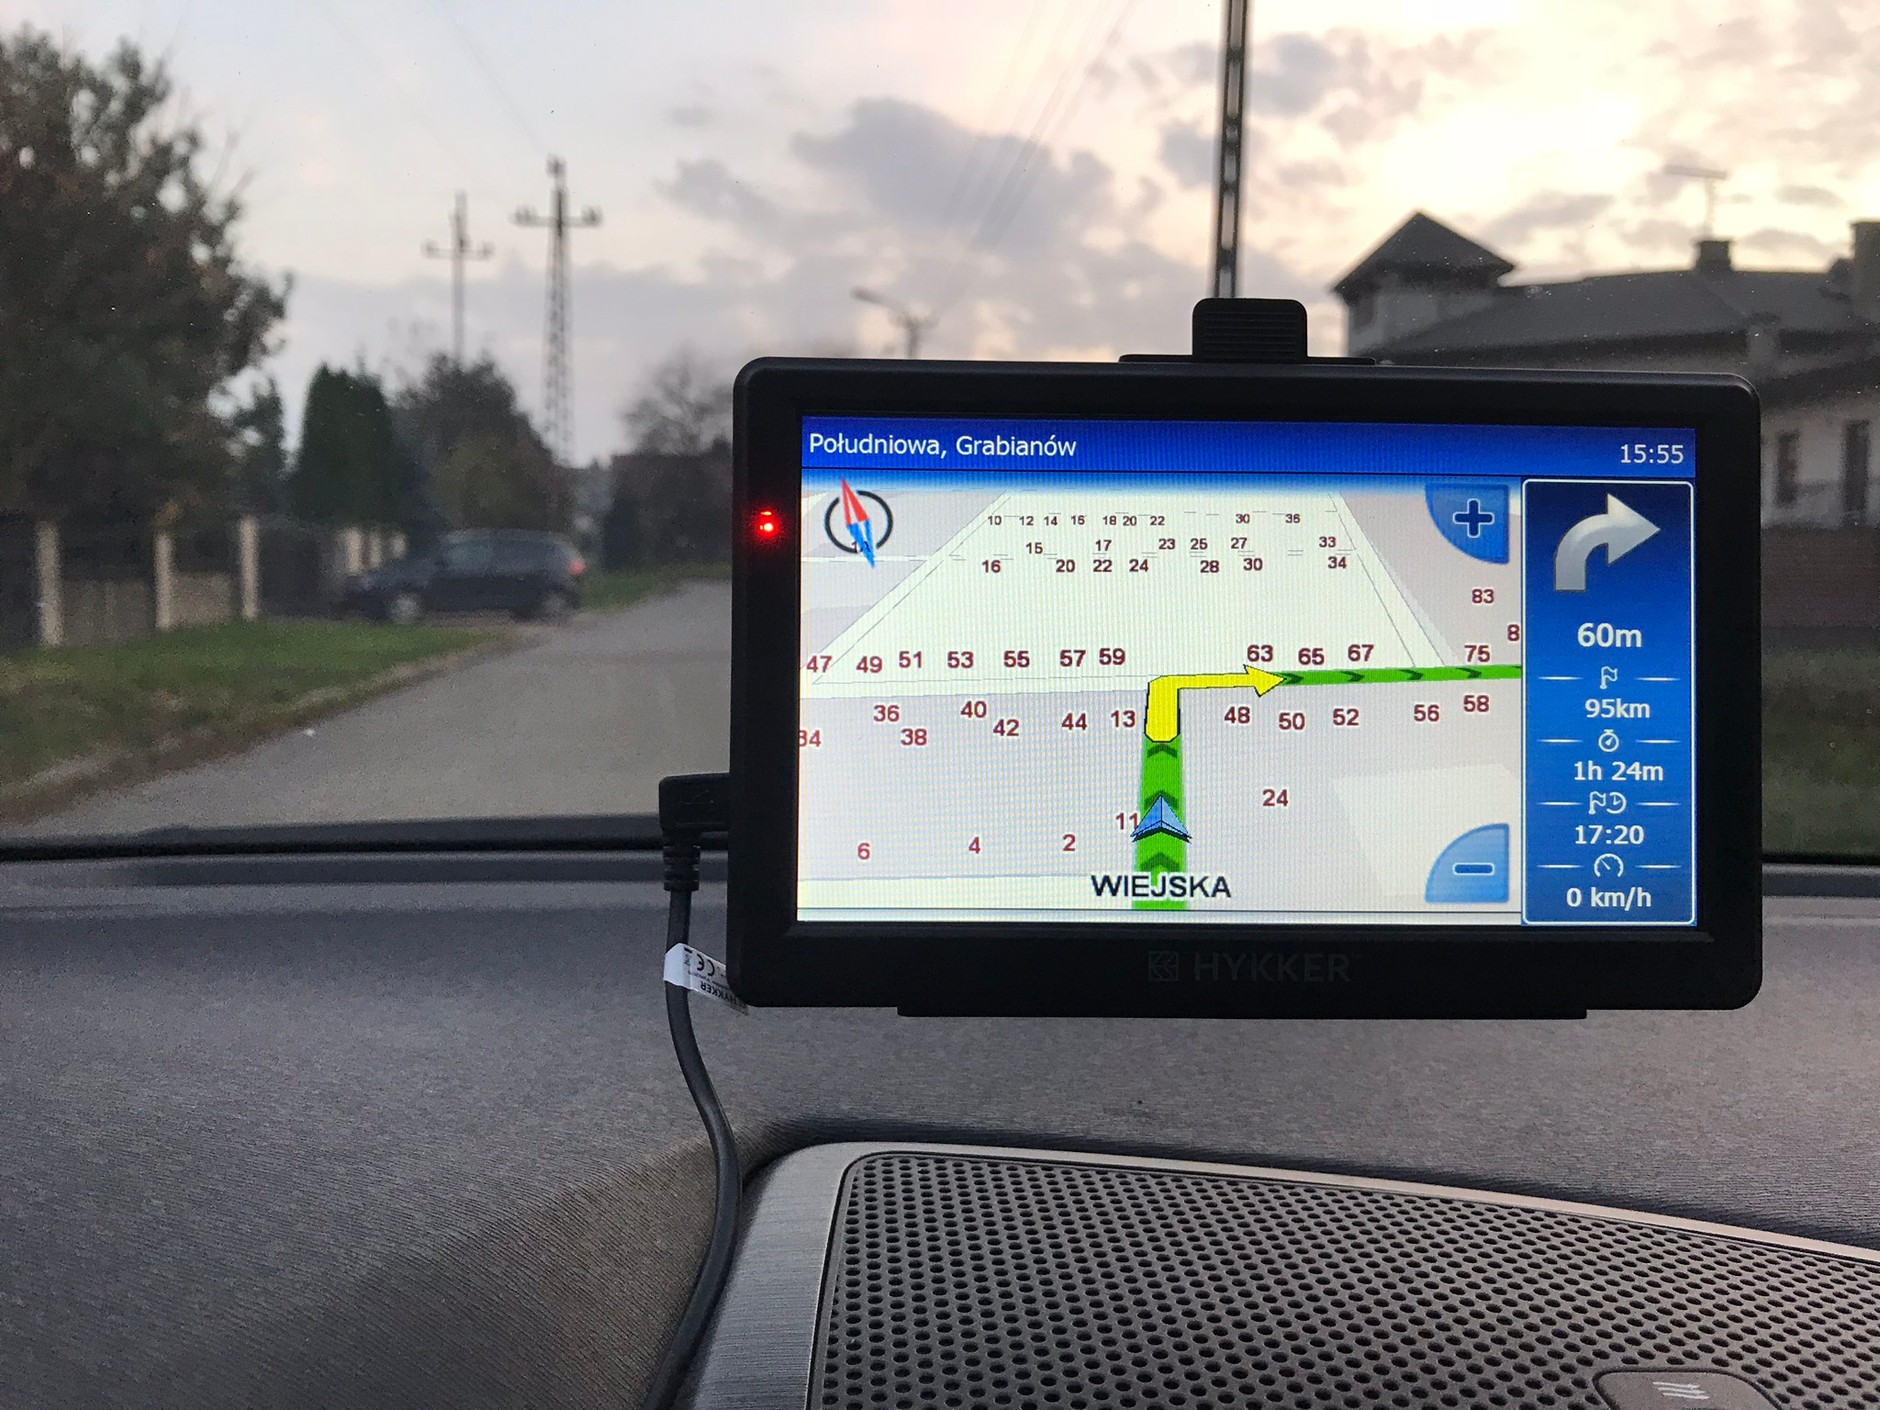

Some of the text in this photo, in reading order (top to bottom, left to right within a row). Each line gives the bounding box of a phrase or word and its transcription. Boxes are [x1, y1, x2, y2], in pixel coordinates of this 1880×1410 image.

[809, 433, 1077, 459] Południowa, Grabianów
[1620, 444, 1685, 464] 15:55
[988, 516, 1002, 526] 10
[1019, 516, 1034, 526] 12
[1044, 516, 1058, 526] 14
[1102, 516, 1117, 525] 18
[1122, 516, 1137, 526] 20
[1150, 516, 1165, 526] 22
[1236, 514, 1250, 524] 30
[1096, 539, 1111, 551] 17
[1158, 538, 1176, 550] 23
[1230, 537, 1248, 549] 27
[1319, 536, 1337, 548] 33
[982, 560, 1001, 573] 16
[1056, 560, 1075, 572] 20
[1093, 560, 1112, 572] 22
[1129, 559, 1149, 572] 24
[1200, 560, 1219, 573] 28
[1243, 558, 1263, 571] 30
[1327, 556, 1347, 569] 34
[1471, 588, 1495, 604] 83
[1577, 622, 1643, 648] 60m
[899, 651, 923, 668] 51
[947, 651, 974, 668] 53
[1004, 651, 1030, 668] 55
[1060, 650, 1086, 667] 57
[1099, 649, 1126, 666] 59
[1247, 644, 1274, 662] 63
[1298, 648, 1325, 665] 65
[1347, 644, 1374, 661] 67
[1465, 645, 1490, 662] 75
[806, 655, 832, 673] 47
[856, 656, 883, 673] 49
[961, 701, 987, 718] 40
[1463, 695, 1490, 712] 58
[1584, 698, 1651, 718] 95km
[873, 704, 900, 722] 36
[1061, 713, 1088, 730] 44
[1111, 710, 1136, 727] 13
[1224, 706, 1251, 724] 48
[1278, 713, 1305, 730] 50
[1332, 709, 1360, 726] 52
[1413, 705, 1440, 722] 56
[993, 719, 1020, 737] 42
[901, 729, 927, 746] 38
[1574, 760, 1664, 781] 1h 24m
[1262, 789, 1289, 807] 24
[1116, 812, 1139, 830] 11
[1063, 834, 1076, 851] 2
[1575, 825, 1645, 845] 17:20
[857, 843, 870, 860] 6
[969, 837, 981, 854] 4
[1091, 875, 1231, 898] WIEJSKA
[1566, 886, 1652, 912] 0 km/h
[1193, 952, 1351, 982] HYKKER
